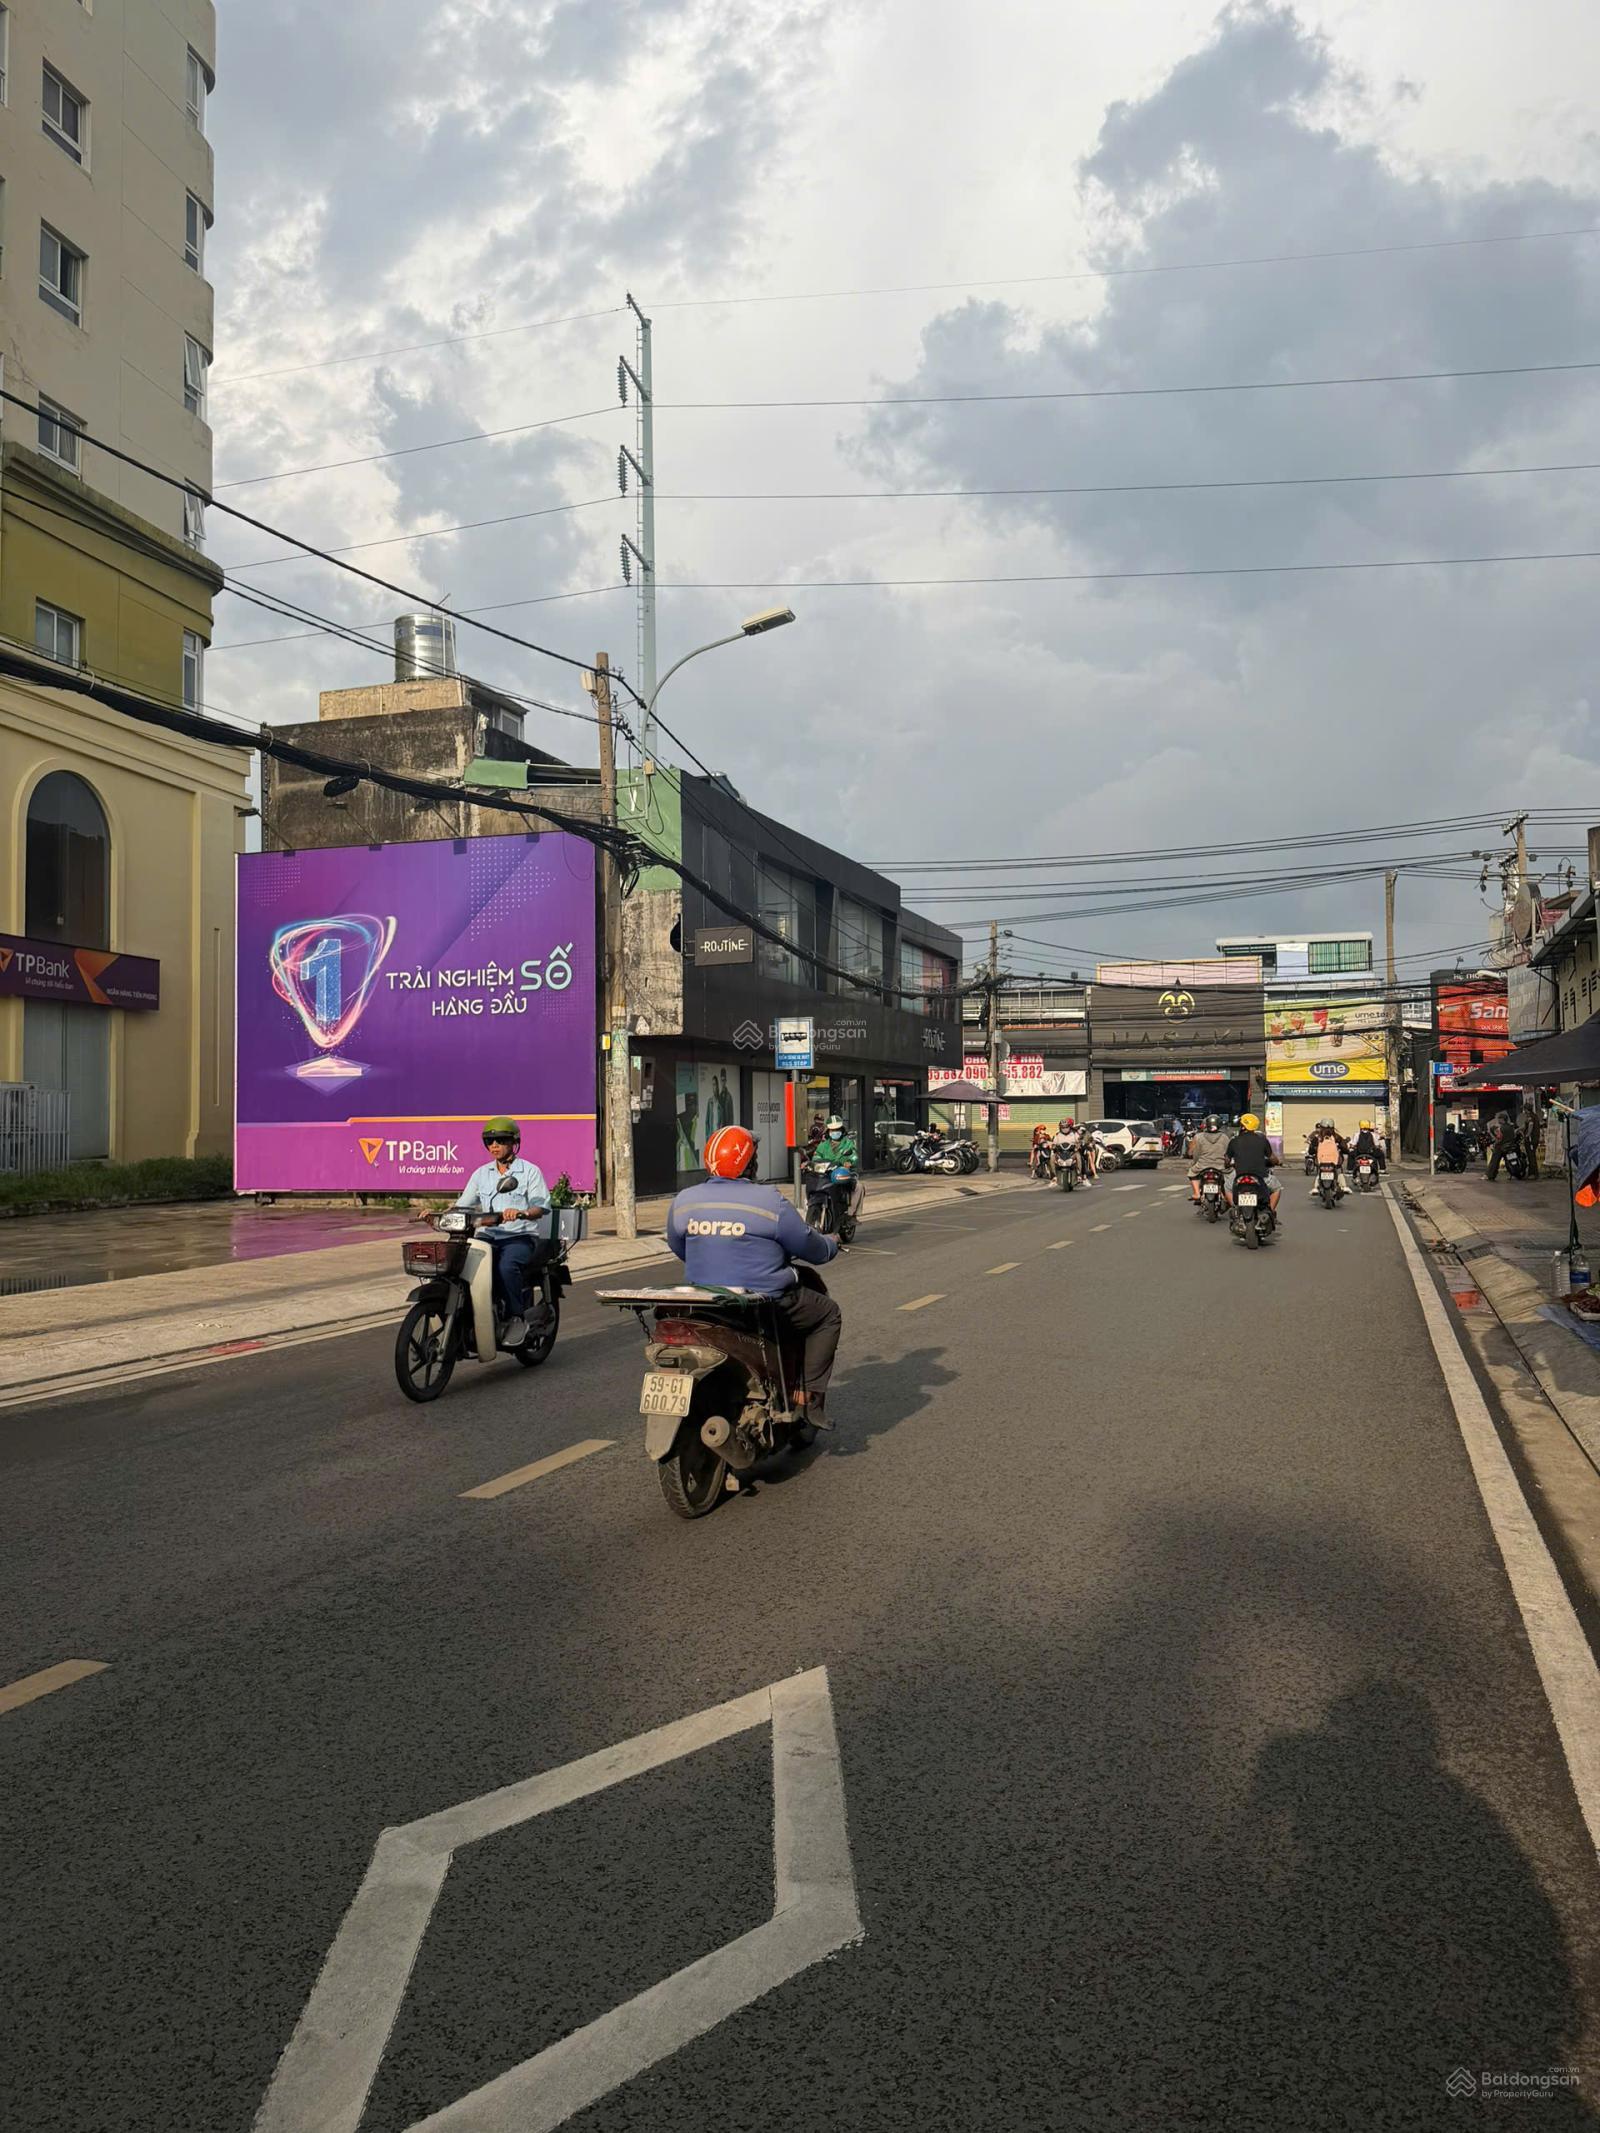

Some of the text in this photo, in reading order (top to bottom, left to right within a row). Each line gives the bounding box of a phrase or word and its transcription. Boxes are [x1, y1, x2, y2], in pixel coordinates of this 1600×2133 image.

[700, 937, 749, 953] ROUTINE
[15, 952, 70, 979] TPBank
[385, 942, 574, 992] TRẢI NGHIỆM SỐ
[431, 989, 527, 1016] HÀNG ĐẦU
[1470, 1001, 1508, 1019] San
[1313, 1064, 1346, 1074] ume
[385, 1139, 458, 1161] TPBank
[687, 1218, 746, 1236] borzo
[650, 1376, 684, 1394] 59-G1
[643, 1393, 687, 1412] 600.79
